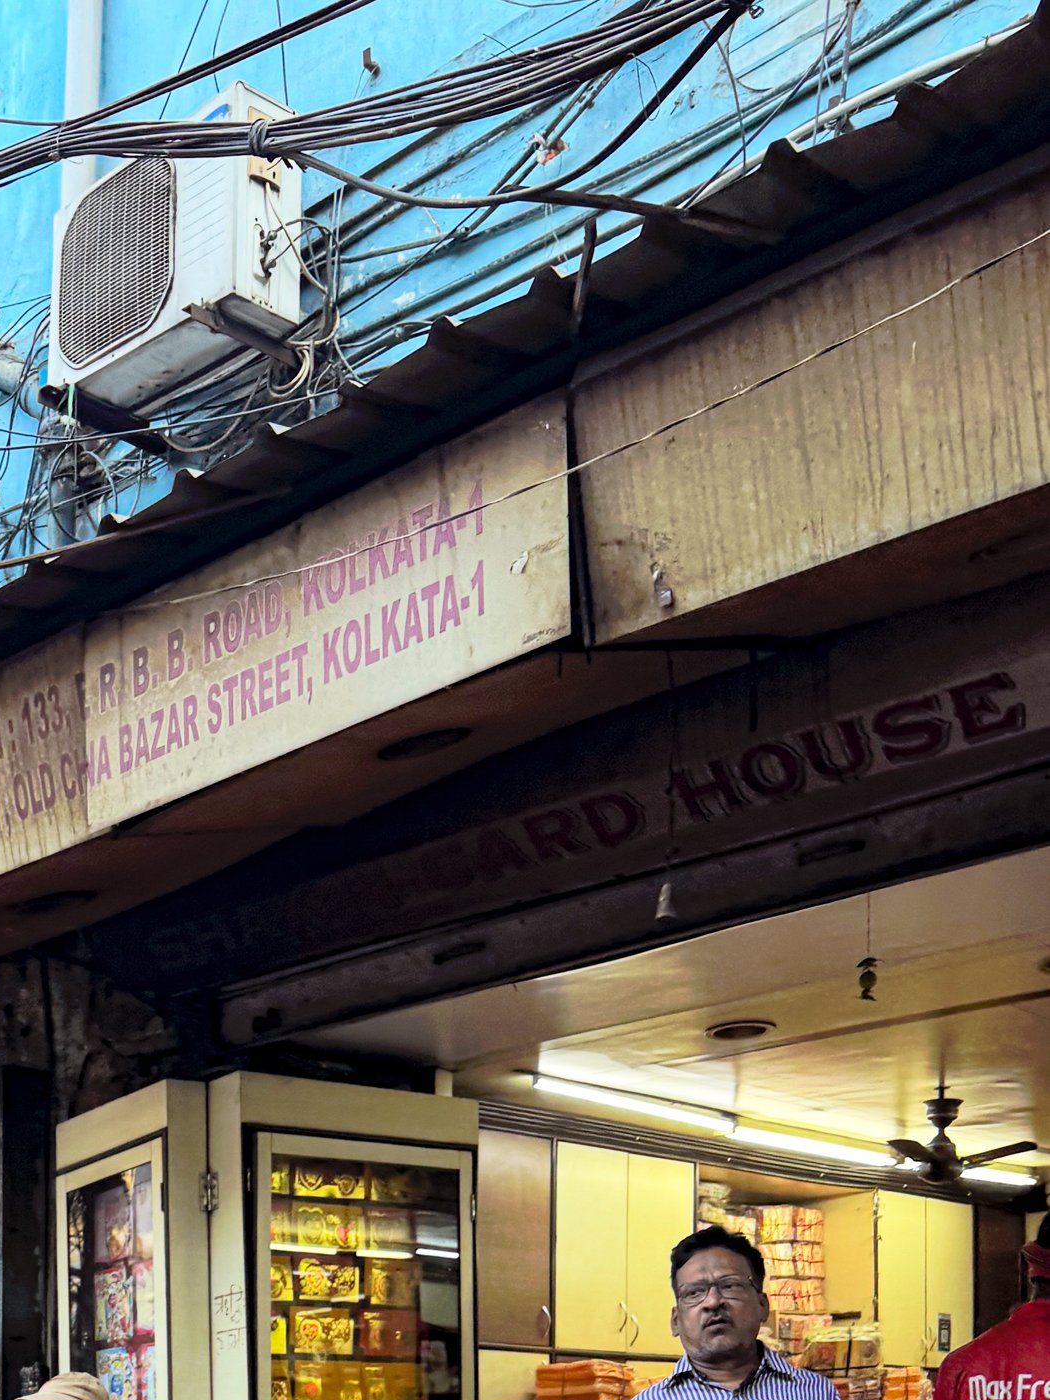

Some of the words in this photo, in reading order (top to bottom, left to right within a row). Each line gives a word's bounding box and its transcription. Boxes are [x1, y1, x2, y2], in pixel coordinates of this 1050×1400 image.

[13, 763, 56, 822] OLD
[119, 695, 200, 774] BAZAR
[207, 641, 314, 735] STREET,
[323, 559, 486, 685] KOLKATA-1
[22, 683, 73, 744] 133,
[133, 646, 159, 698] B.
[167, 628, 194, 682] B.
[204, 580, 293, 665] ROAD,
[302, 478, 484, 617] KOLKATA-1
[674, 670, 1028, 822] HOUSE
